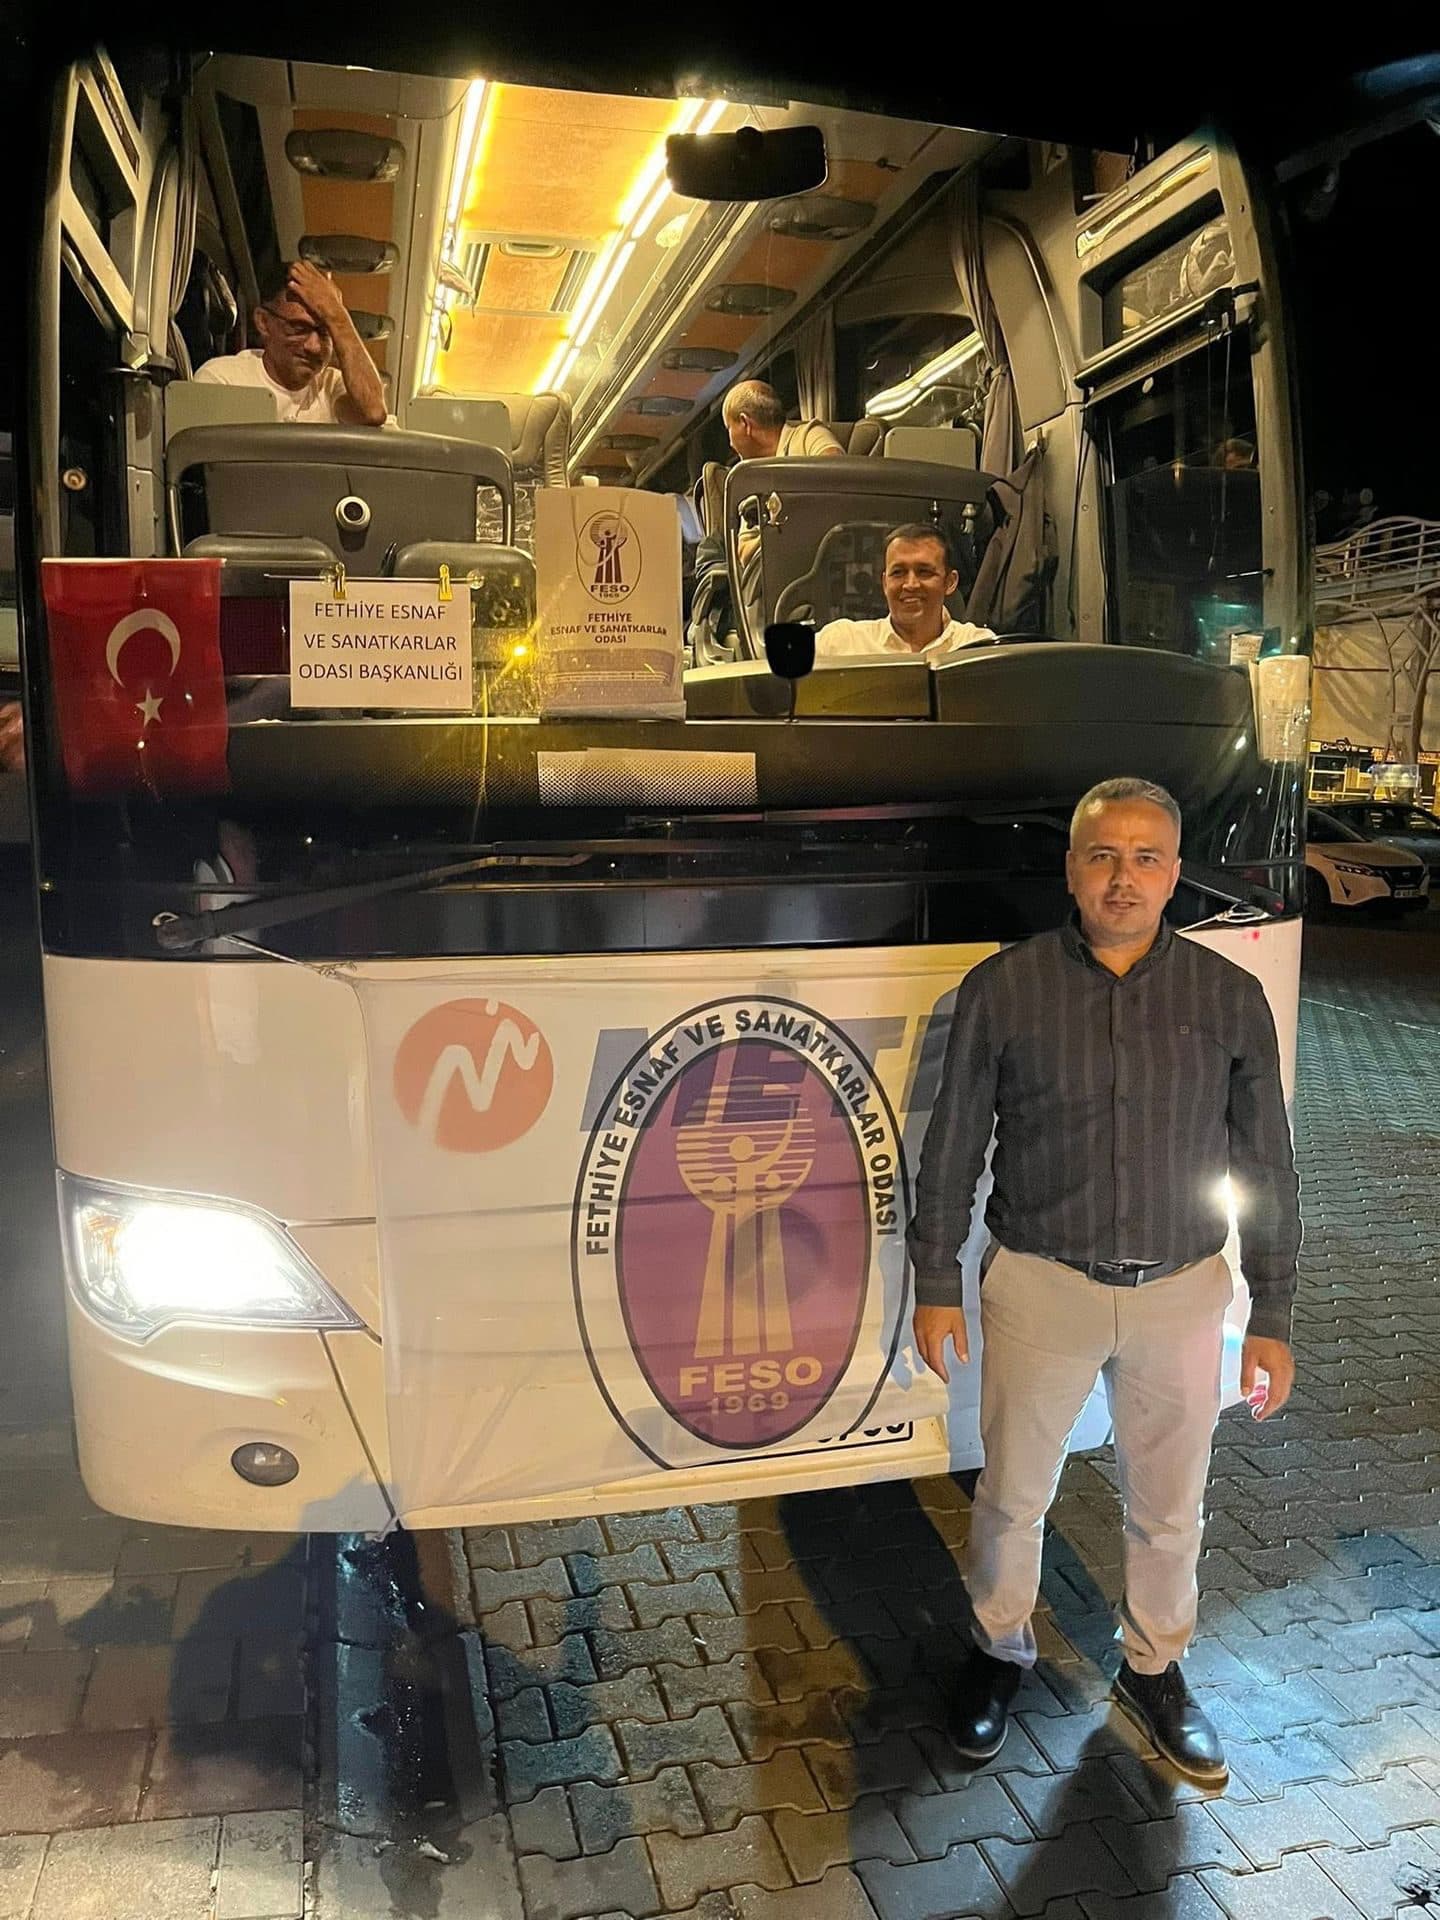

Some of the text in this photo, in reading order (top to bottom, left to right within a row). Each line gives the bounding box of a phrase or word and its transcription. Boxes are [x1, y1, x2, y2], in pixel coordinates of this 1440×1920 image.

[590, 584, 630, 593] FESO
[315, 601, 446, 619] FETHİYE ESNAF
[588, 610, 632, 622] FETHİYE
[551, 624, 667, 636] ESNAF VE SANATKARLAR
[594, 634, 627, 643] ODASI
[304, 634, 457, 650] VE SANATKARLAR
[299, 662, 463, 682] ODASI BAŞKANLIĞI
[586, 1009, 898, 1255] FETHİYE ESNAF VE SANATKARLAR ODASI
[679, 1356, 823, 1397] FESO
[706, 1391, 790, 1415] 1969
